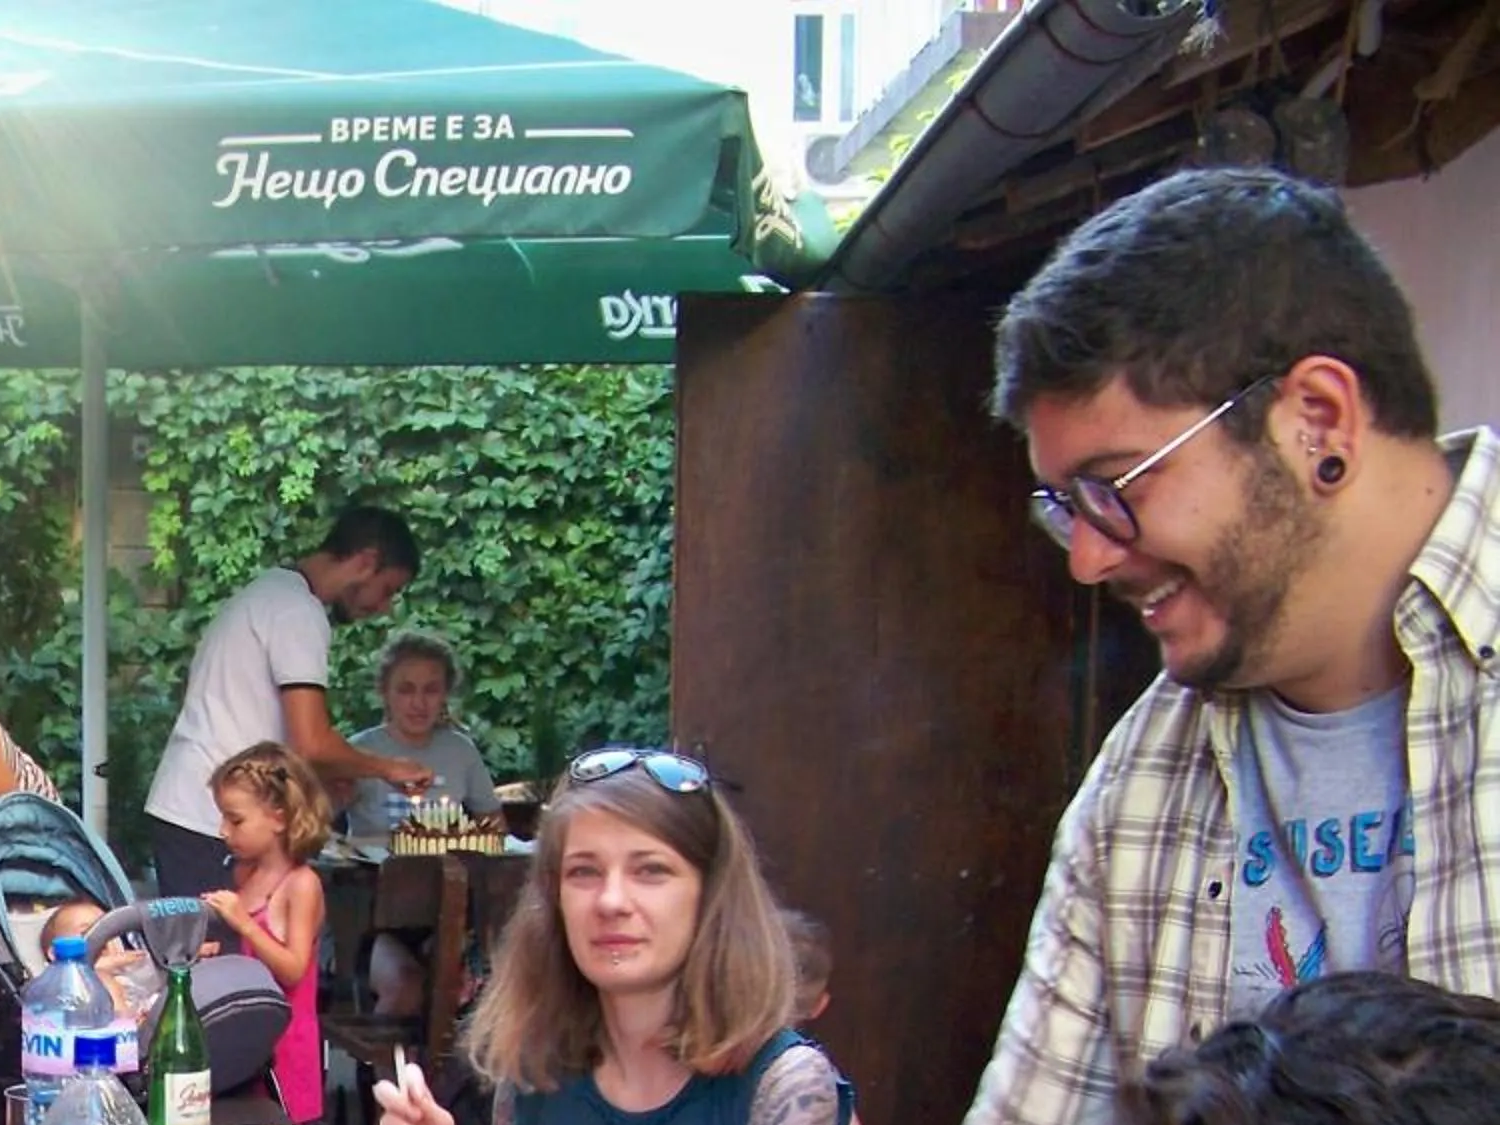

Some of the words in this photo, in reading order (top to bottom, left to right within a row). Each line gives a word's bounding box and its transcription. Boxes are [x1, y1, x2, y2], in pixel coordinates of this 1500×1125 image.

[330, 115, 437, 143] ВРЕМЕ
[445, 114, 464, 140] Е
[472, 113, 515, 139] ЗА
[211, 150, 366, 209] Нещо
[373, 148, 633, 206] Специално
